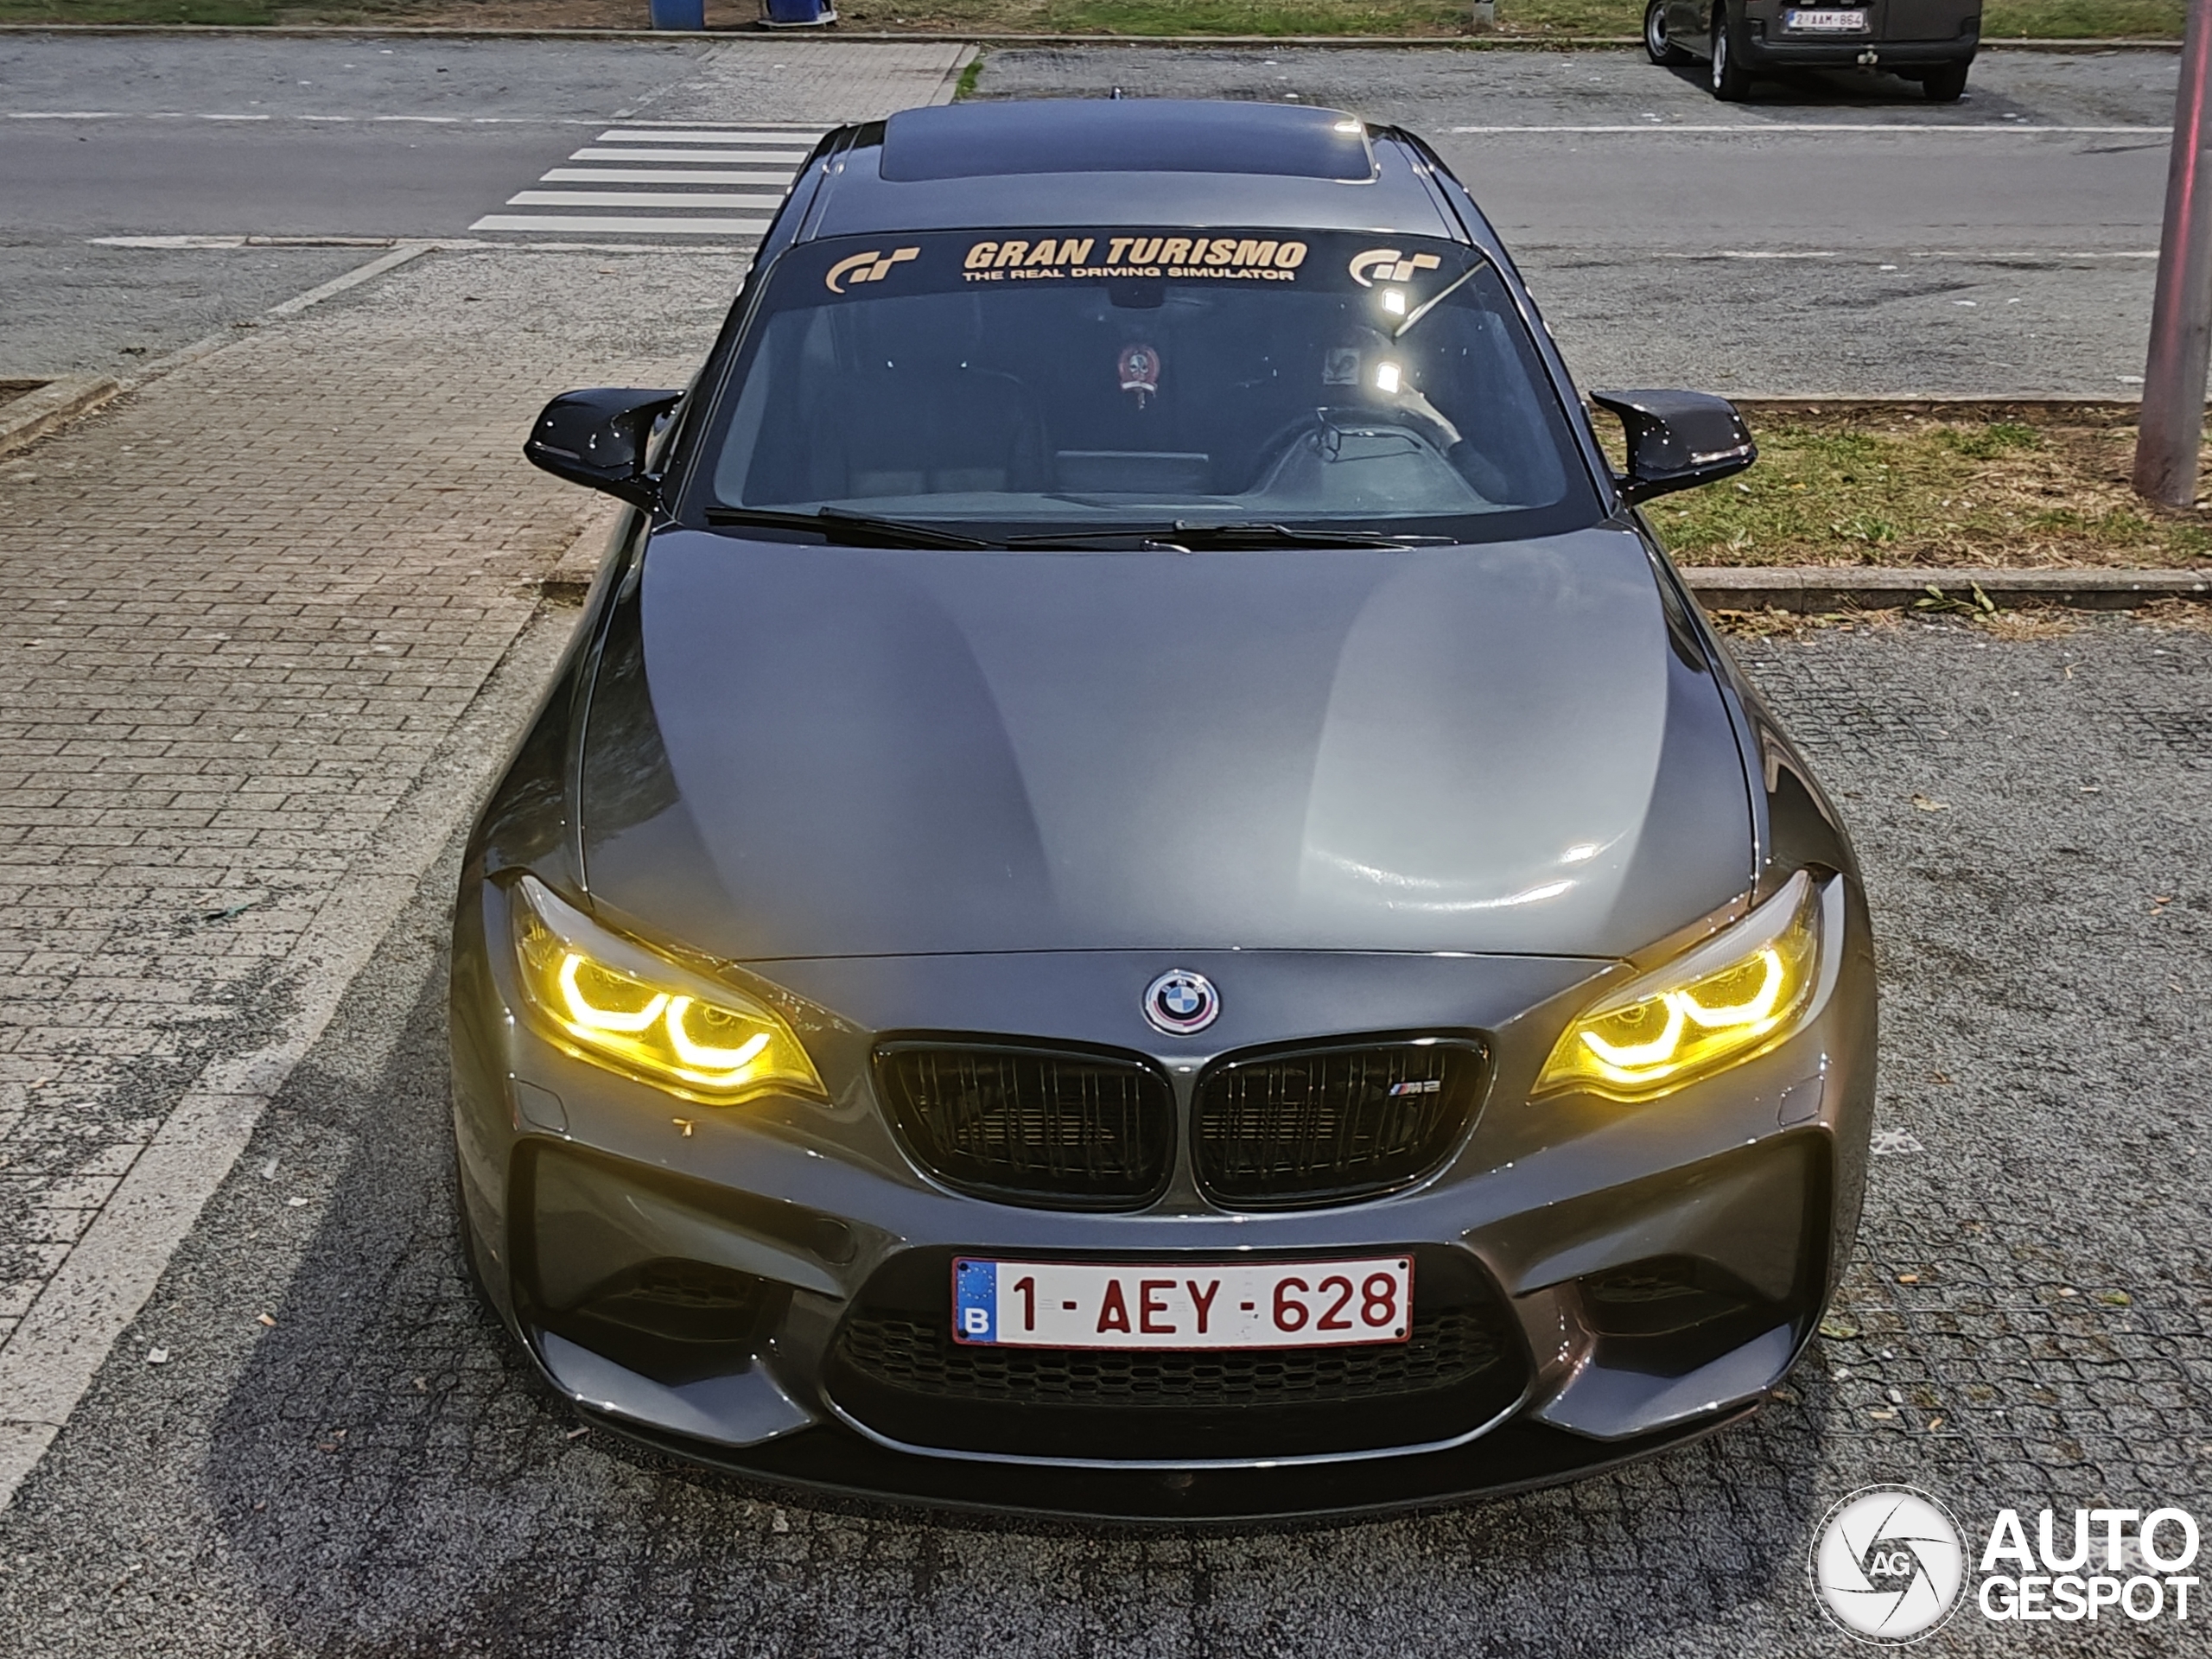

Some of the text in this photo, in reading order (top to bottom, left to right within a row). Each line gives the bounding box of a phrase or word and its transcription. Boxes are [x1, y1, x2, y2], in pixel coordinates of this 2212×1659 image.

[964, 238, 1307, 269] GRAN TURISMO
[963, 267, 1295, 282] THE REAL DRIVING SIMULATOR
[1402, 1080, 1440, 1095] M2
[963, 1307, 989, 1334] B
